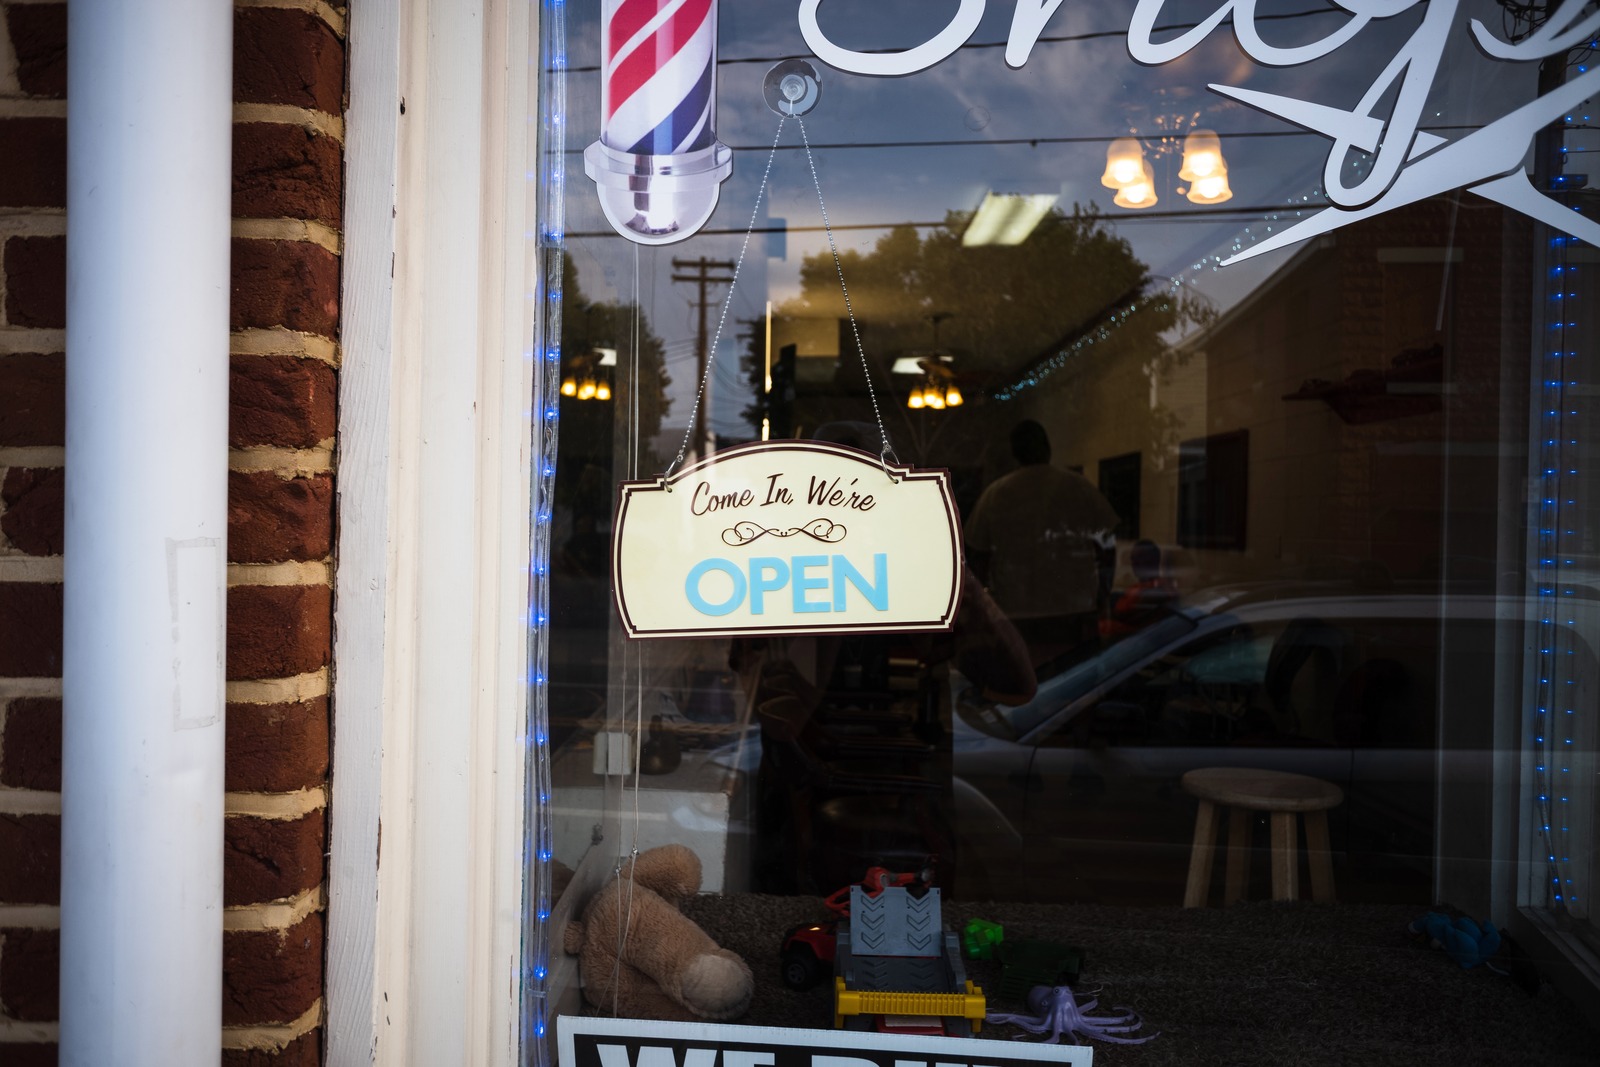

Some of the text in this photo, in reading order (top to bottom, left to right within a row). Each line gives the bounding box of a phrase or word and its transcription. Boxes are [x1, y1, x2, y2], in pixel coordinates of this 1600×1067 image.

[691, 473, 876, 516] Come In, We're
[686, 554, 888, 615] OPEN
